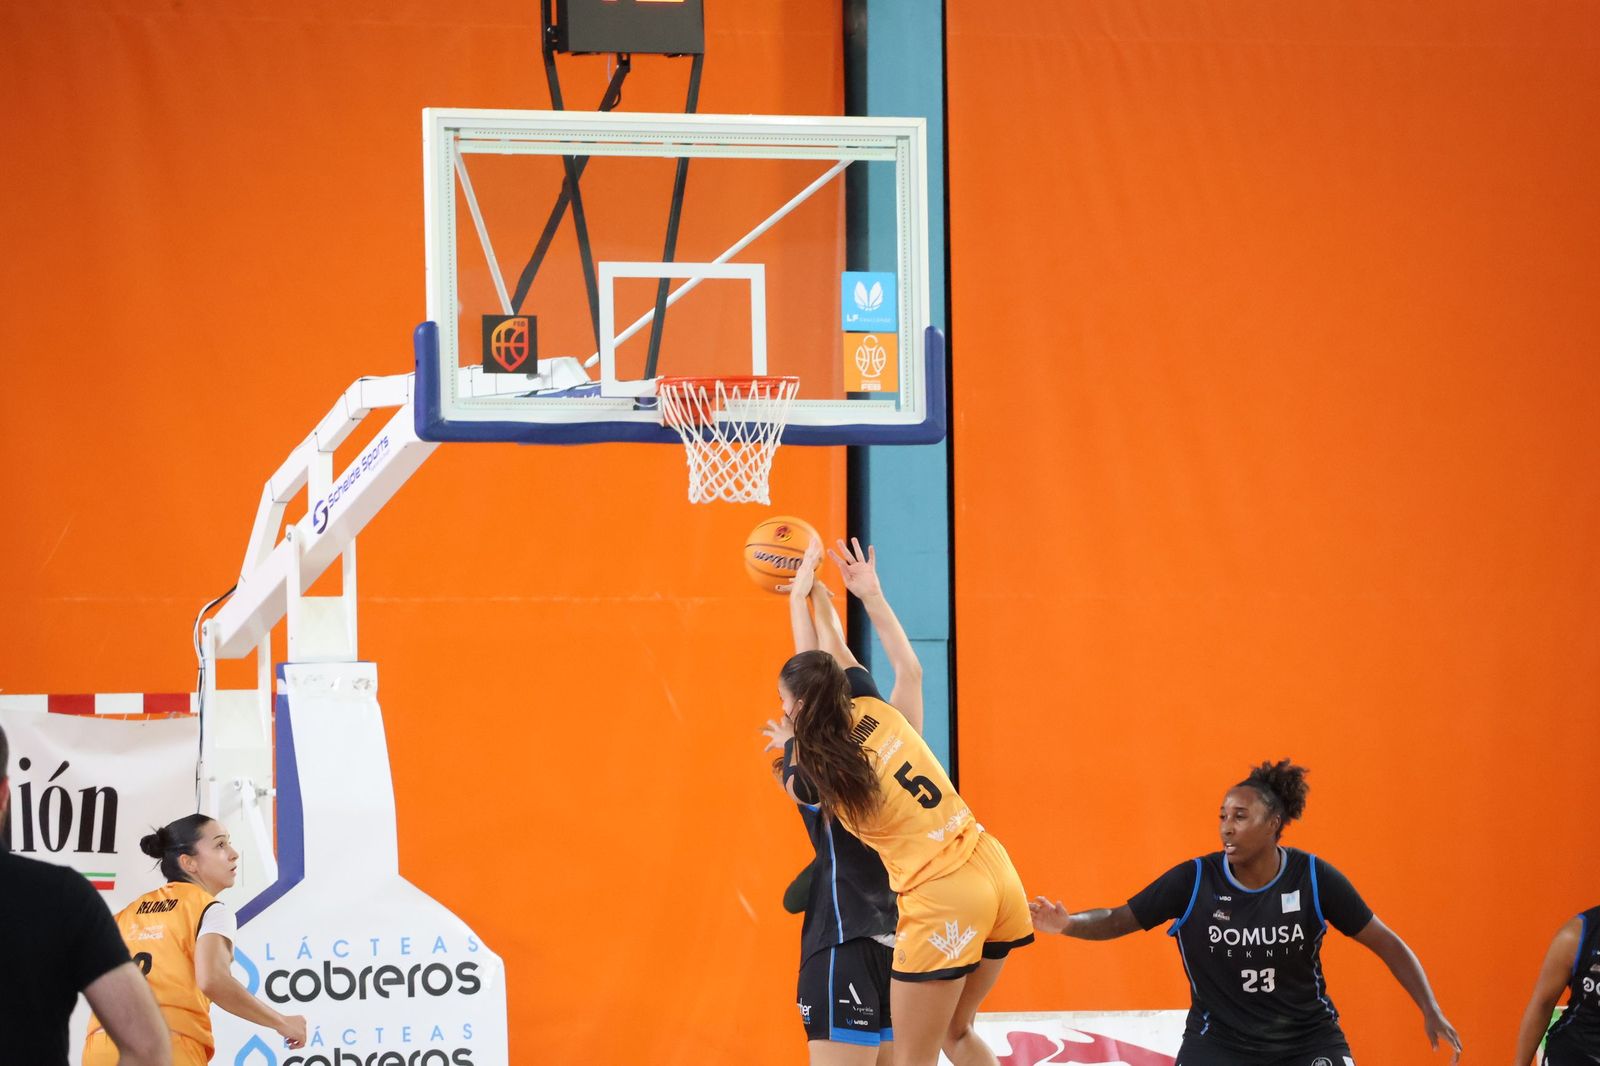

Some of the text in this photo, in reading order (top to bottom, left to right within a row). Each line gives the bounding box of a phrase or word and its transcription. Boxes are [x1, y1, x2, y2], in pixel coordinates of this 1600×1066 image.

[361, 435, 389, 472] Sports
[893, 760, 943, 809] 5
[9, 757, 118, 853] ión
[136, 898, 178, 914] RELANCIO
[265, 935, 479, 961] LÁCTEAS
[1208, 923, 1305, 946] DOMUSA
[264, 960, 481, 1004] cobreros
[1240, 967, 1276, 993] 23
